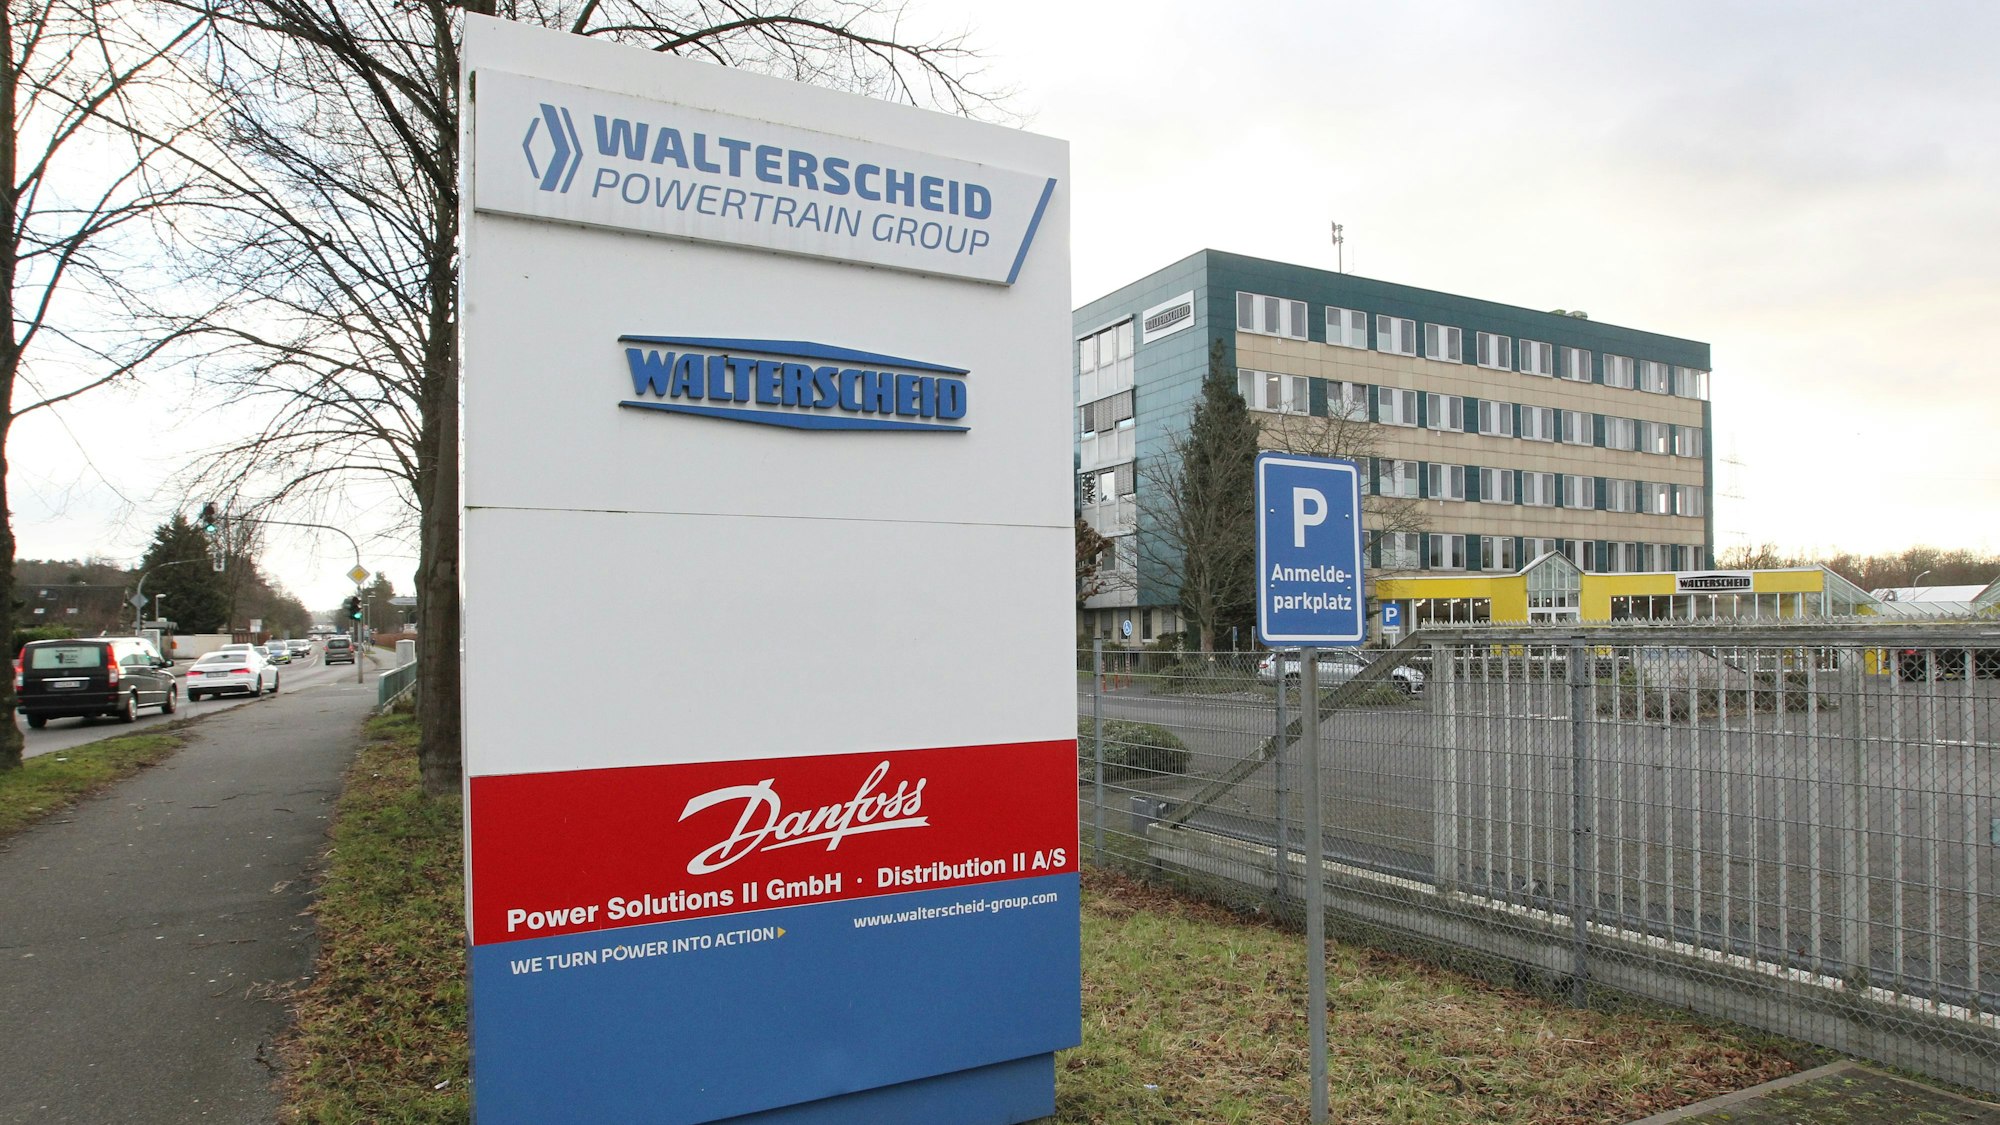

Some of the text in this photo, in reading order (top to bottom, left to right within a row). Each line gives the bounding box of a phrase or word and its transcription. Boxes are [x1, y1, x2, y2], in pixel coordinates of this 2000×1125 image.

[593, 114, 992, 220] WALTERSCHEID
[592, 168, 990, 256] POWERTRAIN GROUP
[625, 348, 968, 420] WALTERSCHEID
[1293, 487, 1328, 548] P
[1271, 563, 1352, 583] Anmelde-
[1680, 578, 1751, 588] WALTERSCHEID
[1274, 592, 1352, 614] parkplatz
[1385, 607, 1398, 623] P
[678, 760, 930, 875] Danfoss
[507, 904, 599, 933] Power
[607, 888, 734, 920] Solutions
[742, 881, 758, 904] II
[766, 873, 842, 901] GmbH
[877, 856, 1006, 888] Distribution
[1012, 852, 1026, 873] II
[1031, 847, 1067, 871] A/S
[854, 892, 1058, 929] www.walterscheid-group.com
[510, 926, 775, 975] WE TURN POWER INTO ACTION
